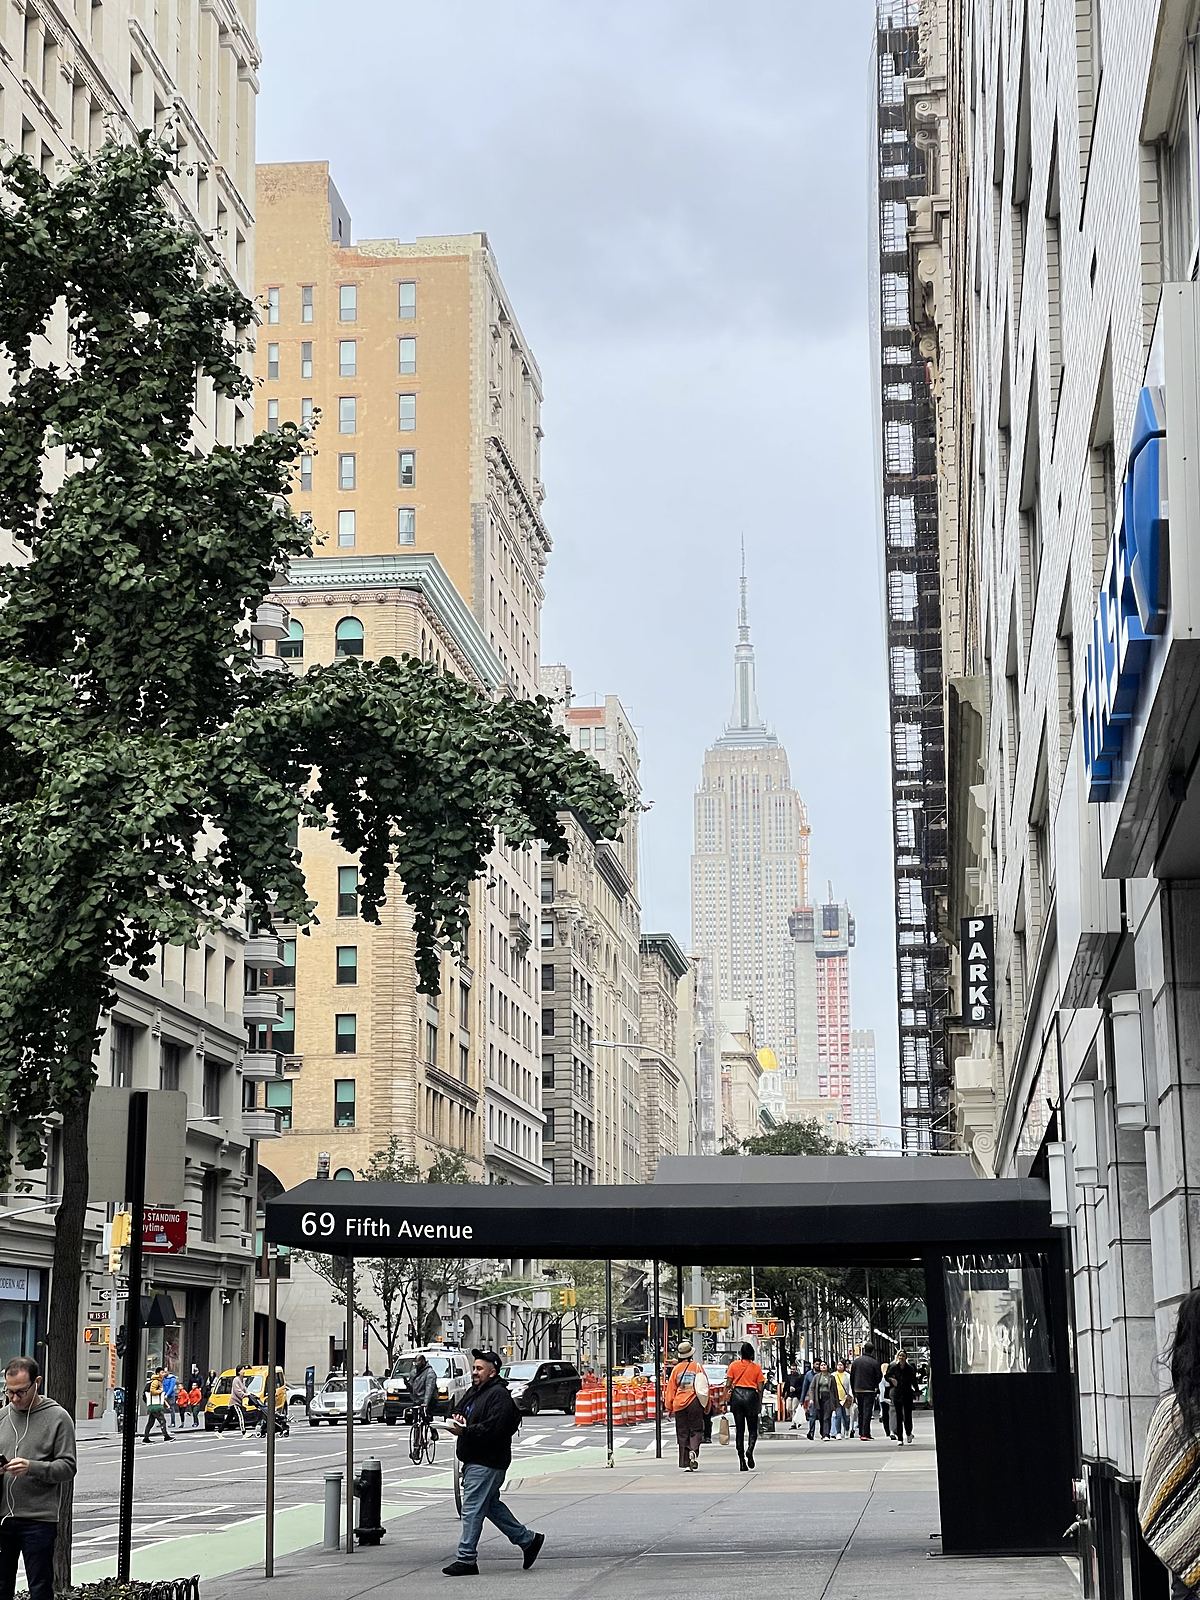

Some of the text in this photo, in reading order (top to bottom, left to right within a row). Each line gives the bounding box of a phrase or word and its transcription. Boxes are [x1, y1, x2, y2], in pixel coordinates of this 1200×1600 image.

[967, 919, 991, 1006] PARK
[147, 1212, 180, 1223] STANDING
[301, 1211, 473, 1239] 69 Fifth Avenue
